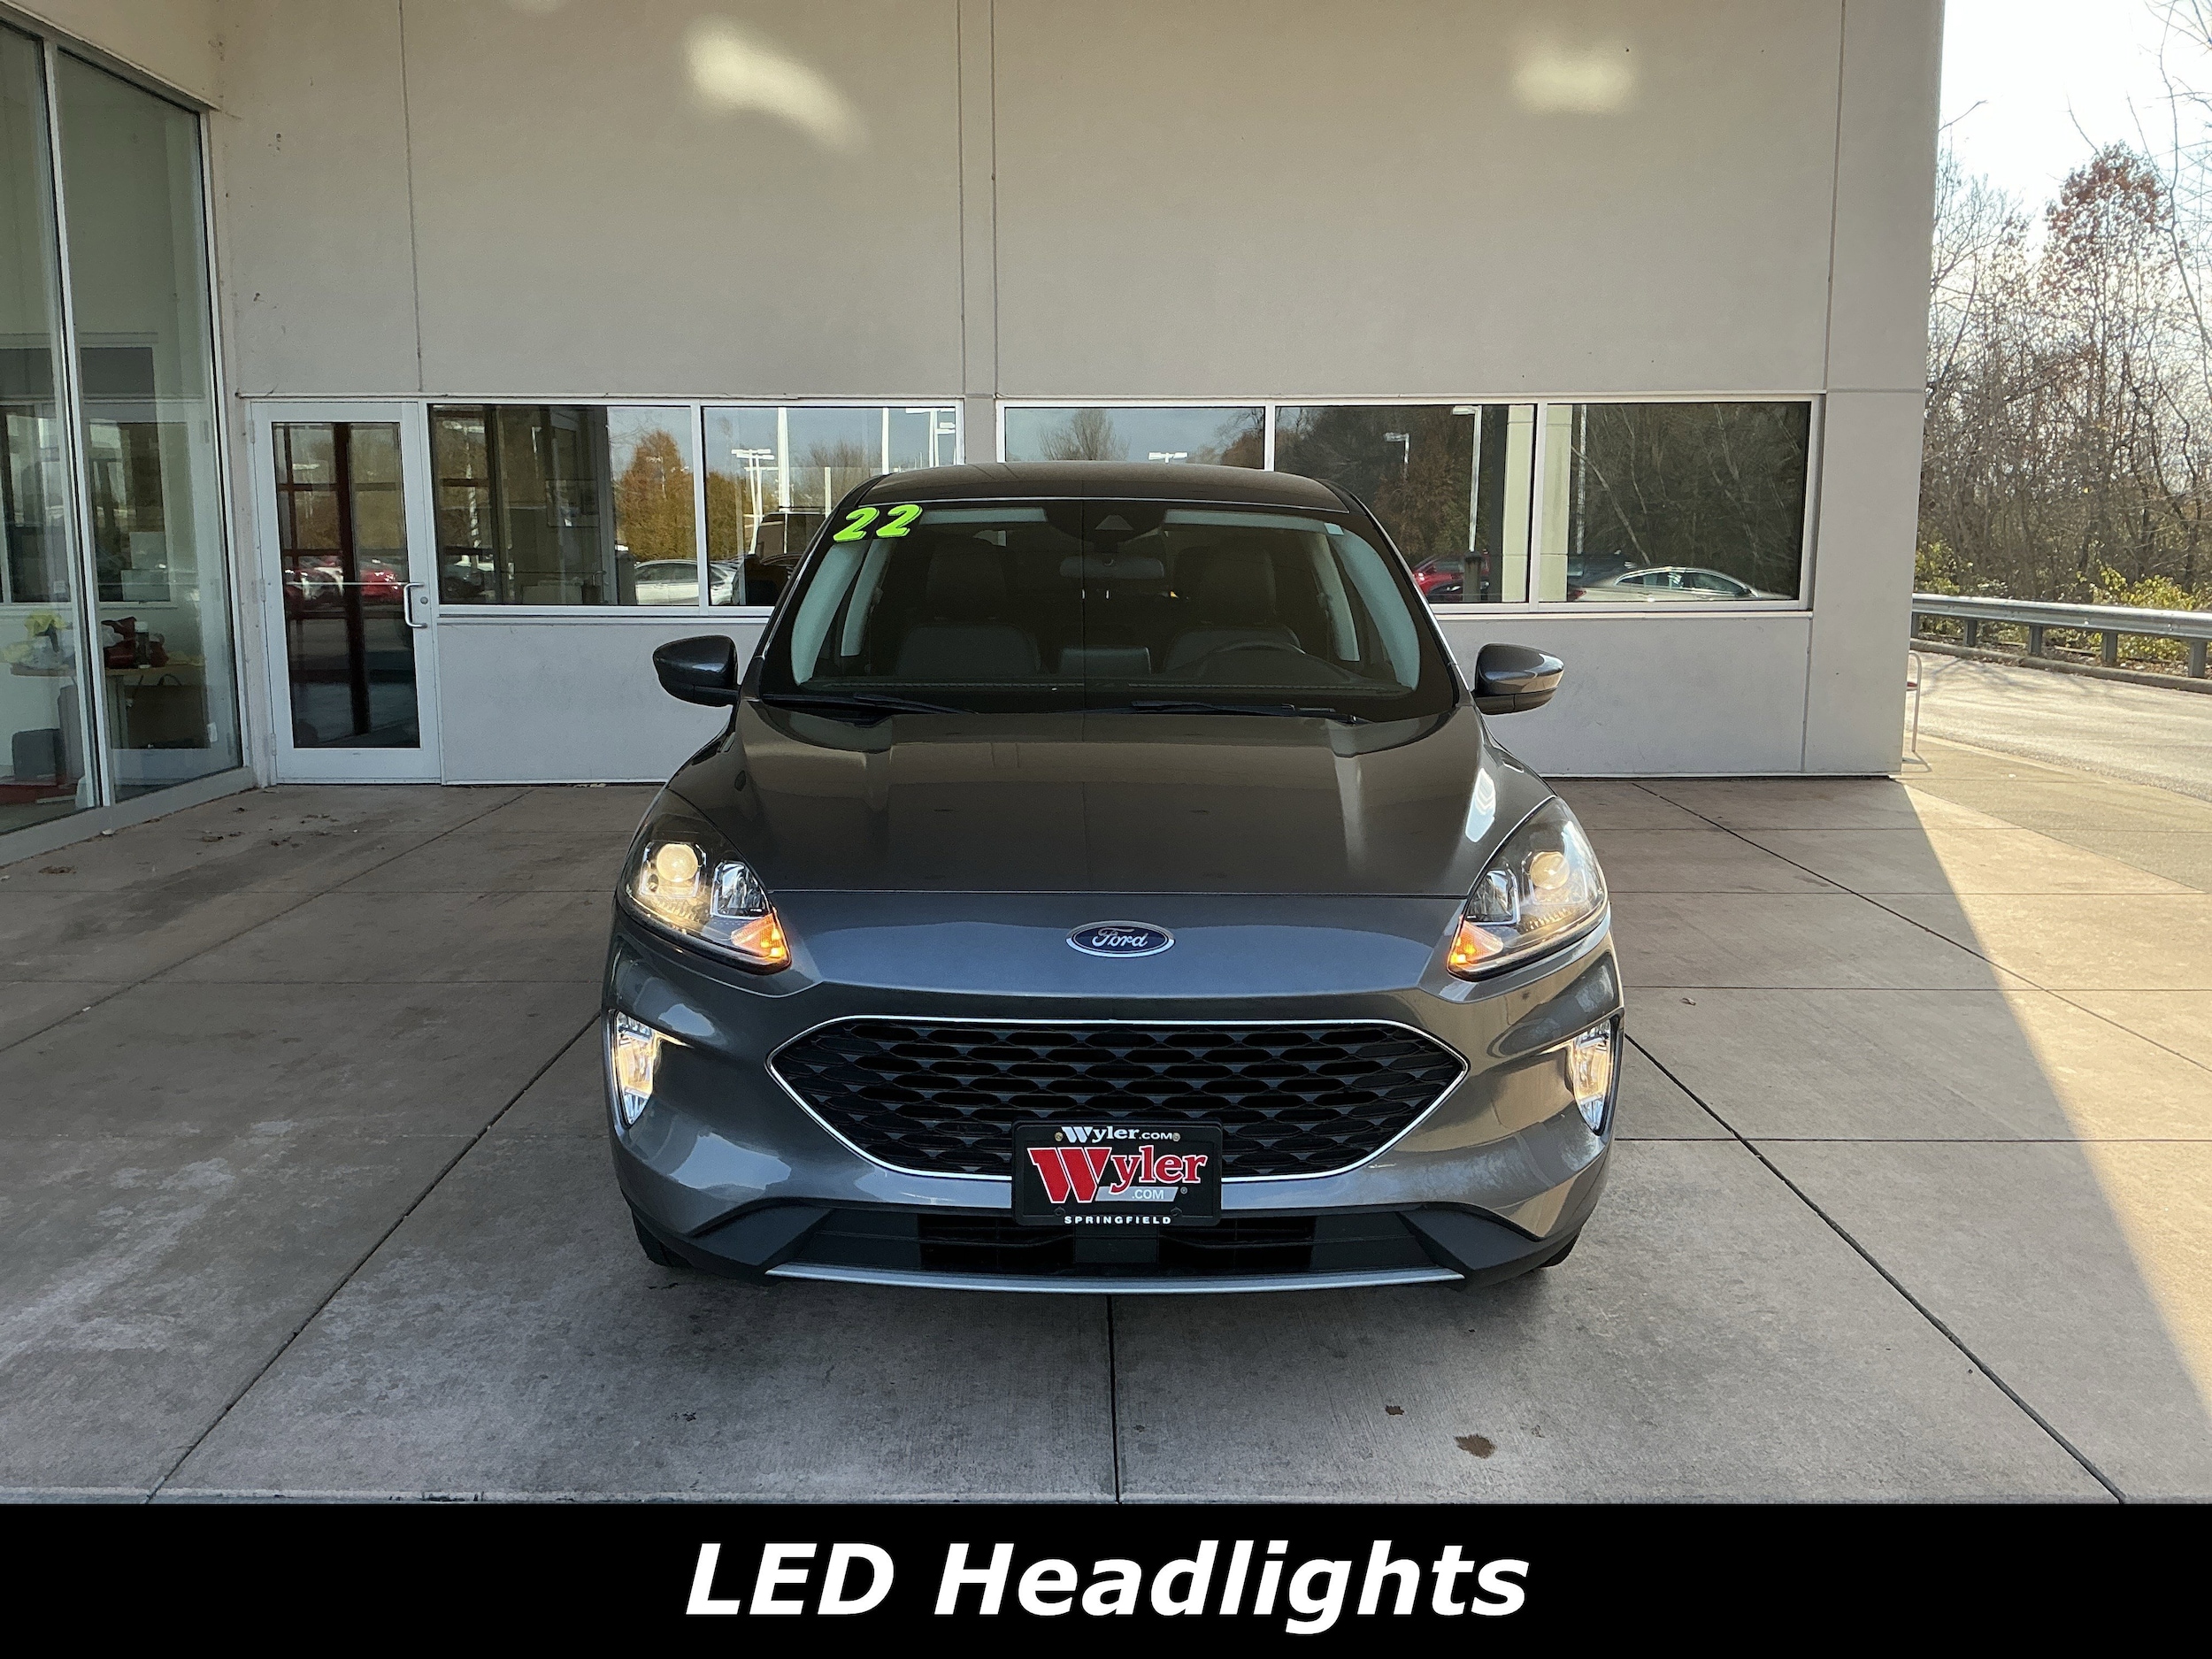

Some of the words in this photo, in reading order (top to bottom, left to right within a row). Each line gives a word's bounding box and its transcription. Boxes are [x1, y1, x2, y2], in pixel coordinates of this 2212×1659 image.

[833, 503, 923, 542] 22
[1091, 926, 1148, 947] Ford
[1027, 1145, 1208, 1203] Wyler
[1064, 1215, 1171, 1225] SPRINGFIELD
